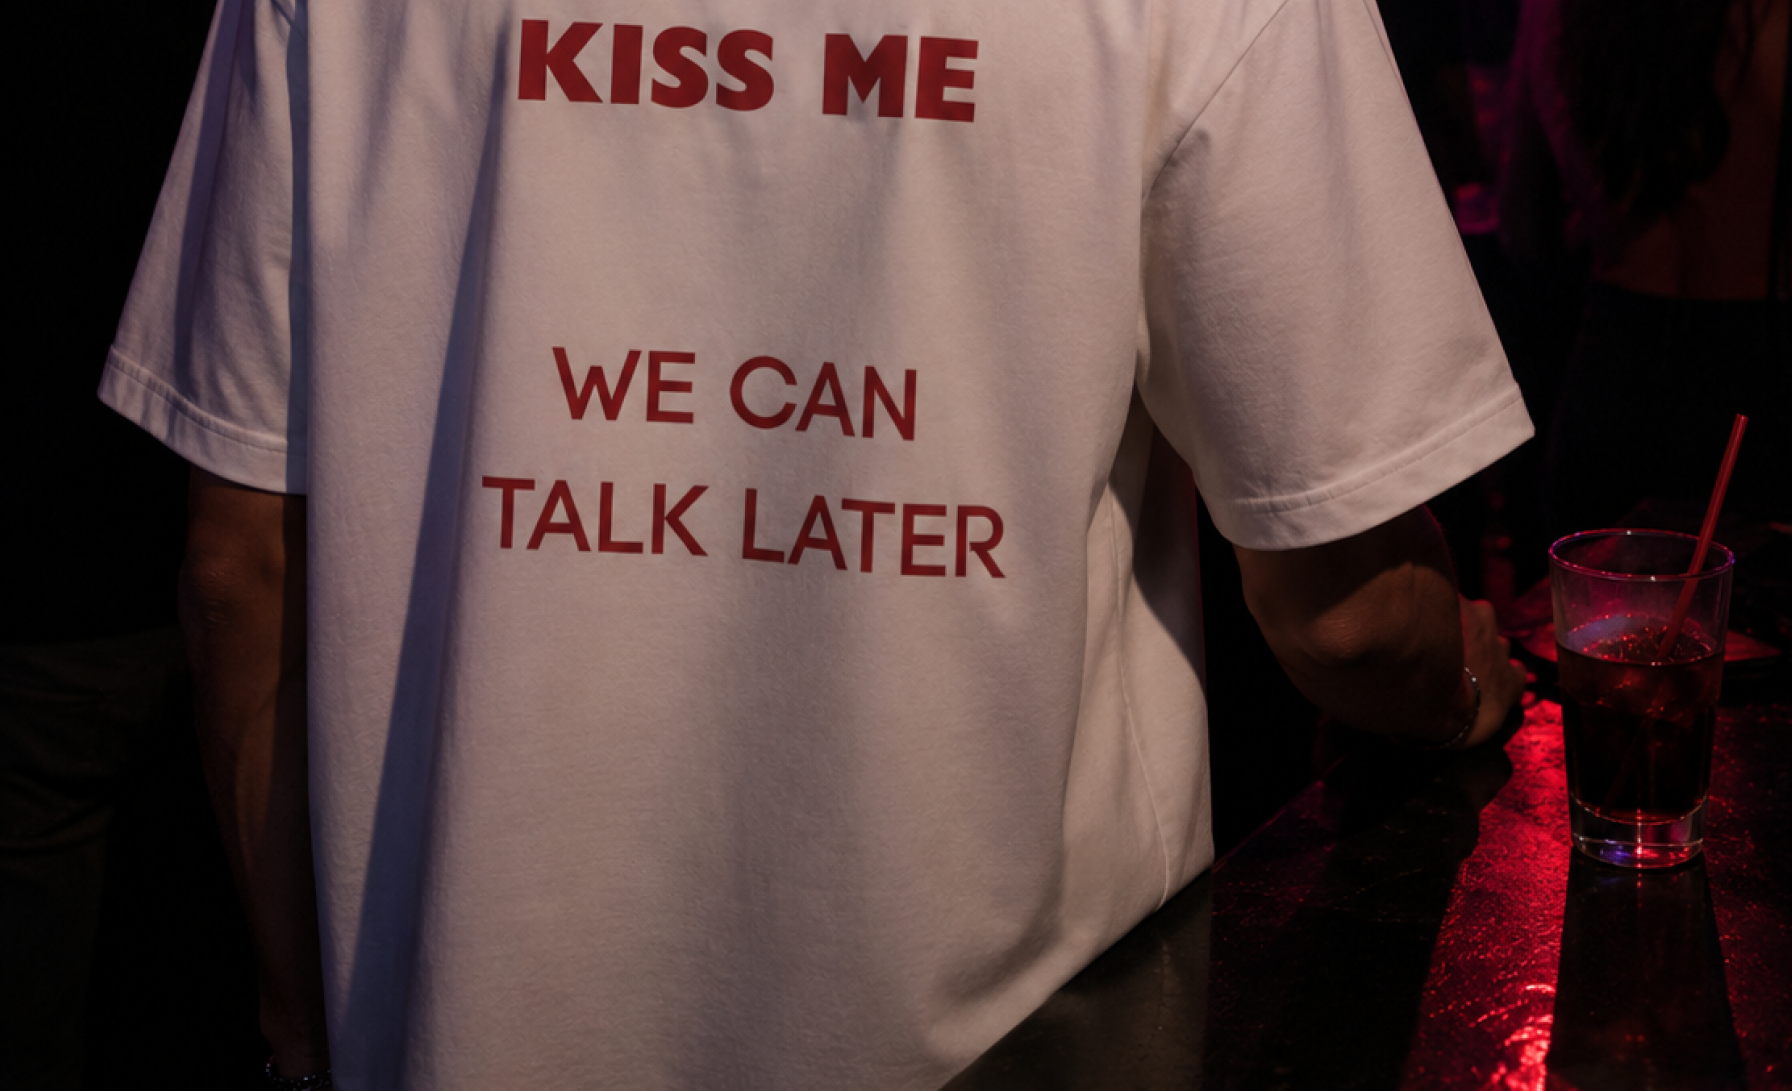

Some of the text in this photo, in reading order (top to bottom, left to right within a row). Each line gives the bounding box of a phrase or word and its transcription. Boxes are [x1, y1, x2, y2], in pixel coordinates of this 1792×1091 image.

[518, 19, 978, 122] KISS ME
[553, 347, 918, 441] WE CAN
[482, 476, 1005, 578] TALK LATER
